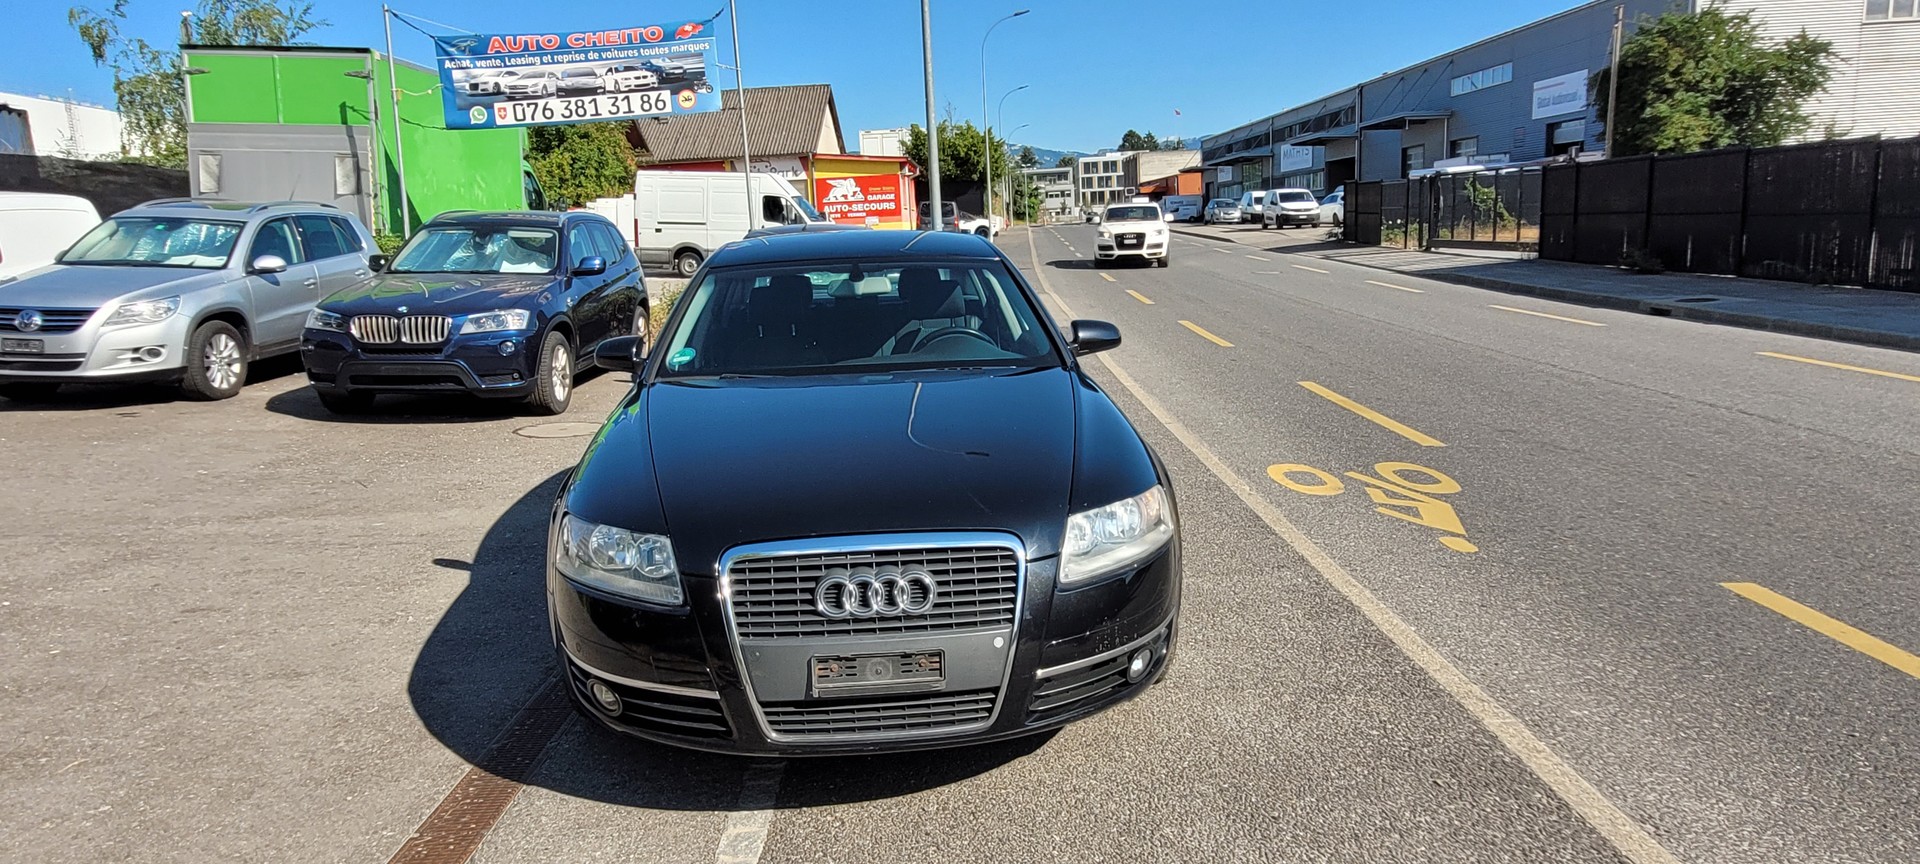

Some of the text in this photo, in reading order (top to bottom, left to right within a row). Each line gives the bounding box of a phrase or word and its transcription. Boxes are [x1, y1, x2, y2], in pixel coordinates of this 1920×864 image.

[488, 26, 664, 54] AUTO CHEITO
[444, 42, 710, 69] Achat, vente, Leasing et reprise de voitures toutes marques
[512, 93, 667, 122] 076 381 31 86
[824, 202, 896, 213] AUTO-SECOURS
[867, 193, 895, 201] GARAGE
